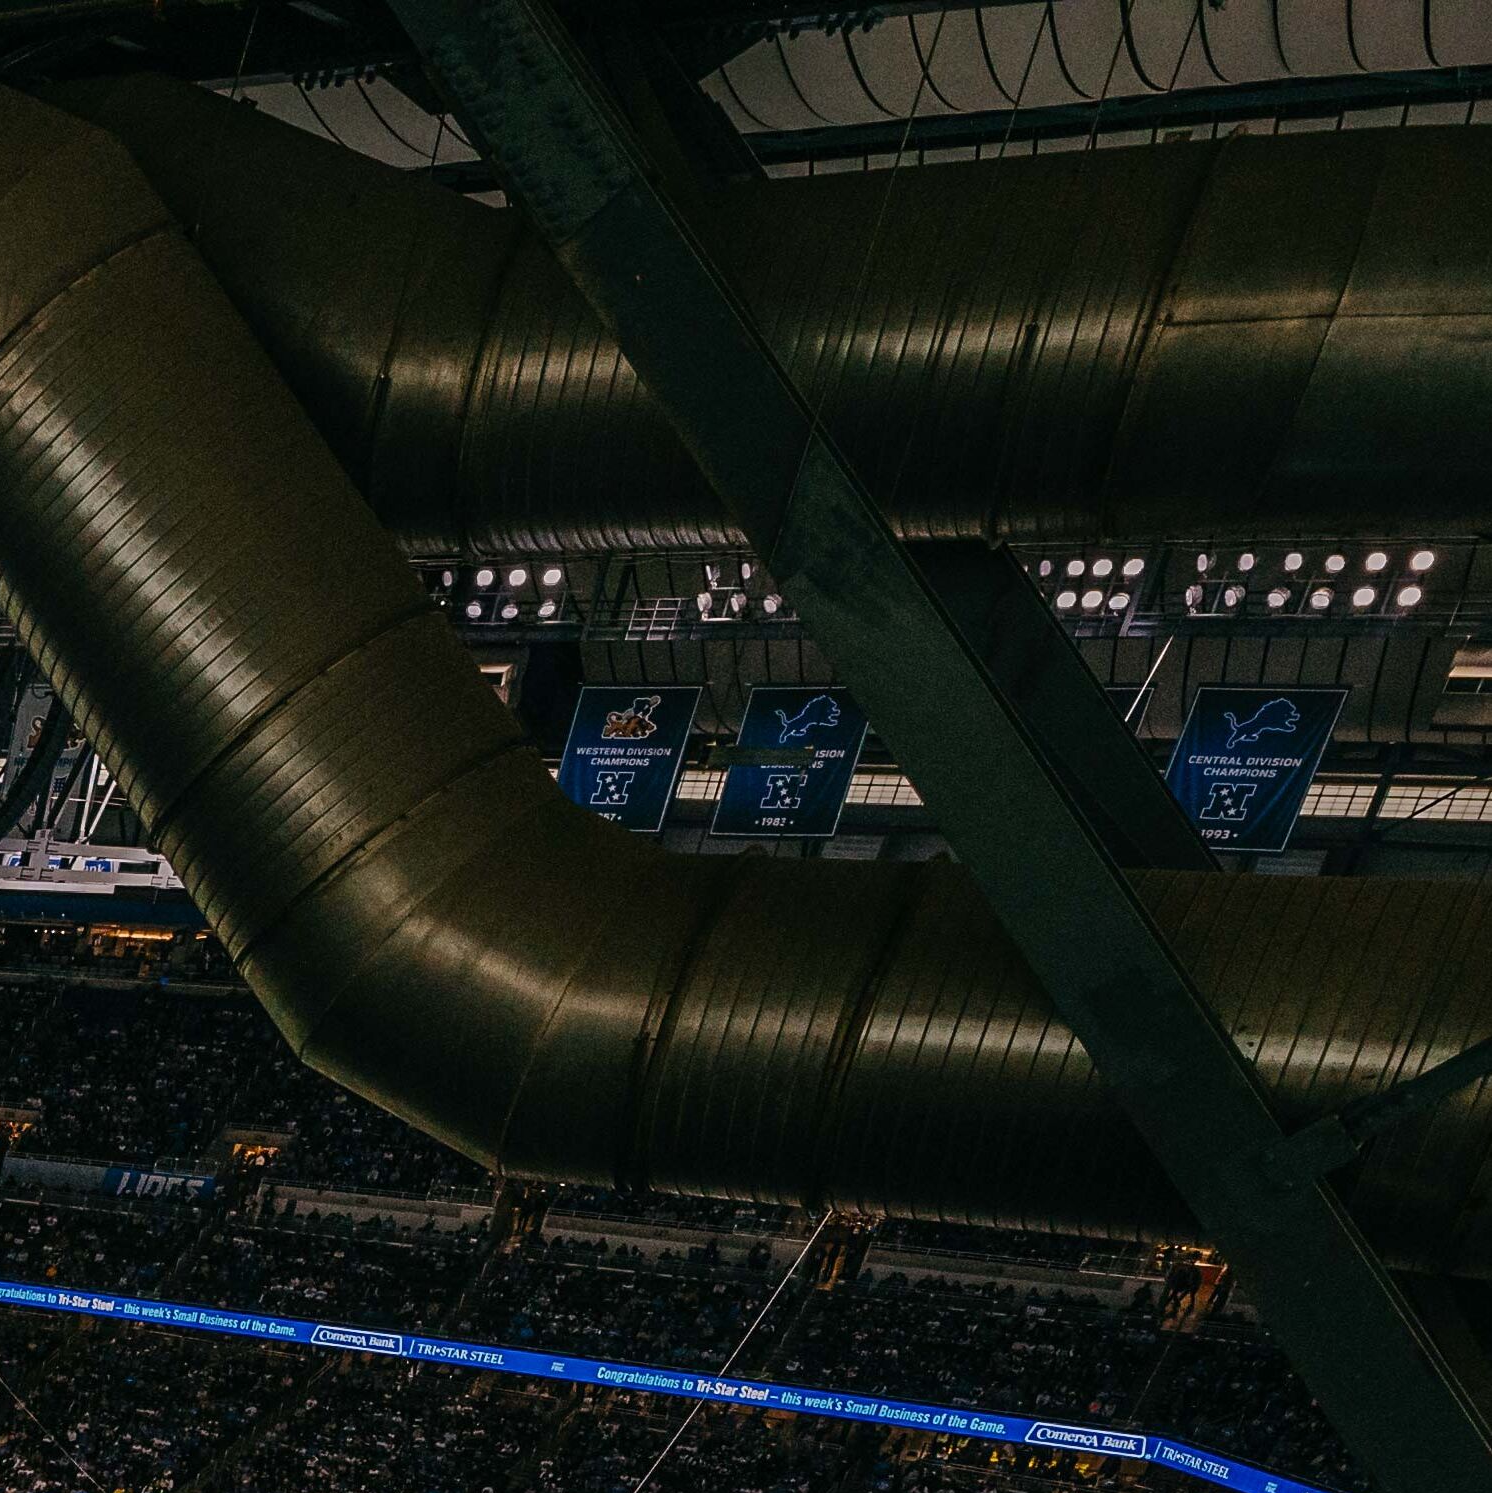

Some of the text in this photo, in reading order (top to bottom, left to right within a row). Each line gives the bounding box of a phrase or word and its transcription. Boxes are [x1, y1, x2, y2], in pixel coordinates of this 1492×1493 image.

[576, 747, 671, 757] WESTERN DIVISION
[590, 757, 650, 766] CHAMPIONS
[1188, 754, 1303, 768] CENTRAL DIVISION
[1203, 768, 1277, 778] CHAMPIONS
[1201, 829, 1230, 840] 1993
[48, 1292, 57, 1303] to
[58, 1293, 91, 1309] Tri-Star
[92, 1297, 115, 1311] Steel
[124, 1302, 140, 1315] this
[172, 1308, 197, 1323] Small
[198, 1312, 239, 1330] Business
[240, 1317, 250, 1330] of
[251, 1318, 266, 1331] the
[269, 1322, 297, 1337] Game.
[368, 1335, 396, 1349] Bank
[469, 1351, 505, 1365] STEEL
[597, 1366, 680, 1390] Congratulations
[681, 1378, 694, 1391] to
[696, 1378, 737, 1397] Tri-Star
[738, 1385, 768, 1400] Steel
[781, 1391, 802, 1406] this
[845, 1400, 877, 1416] Small
[878, 1404, 929, 1423] Business
[932, 1412, 948, 1426] of
[948, 1414, 967, 1428] the
[970, 1416, 1006, 1434] Game.
[1102, 1435, 1137, 1451] Bank
[1201, 1459, 1229, 1480] STEEL
